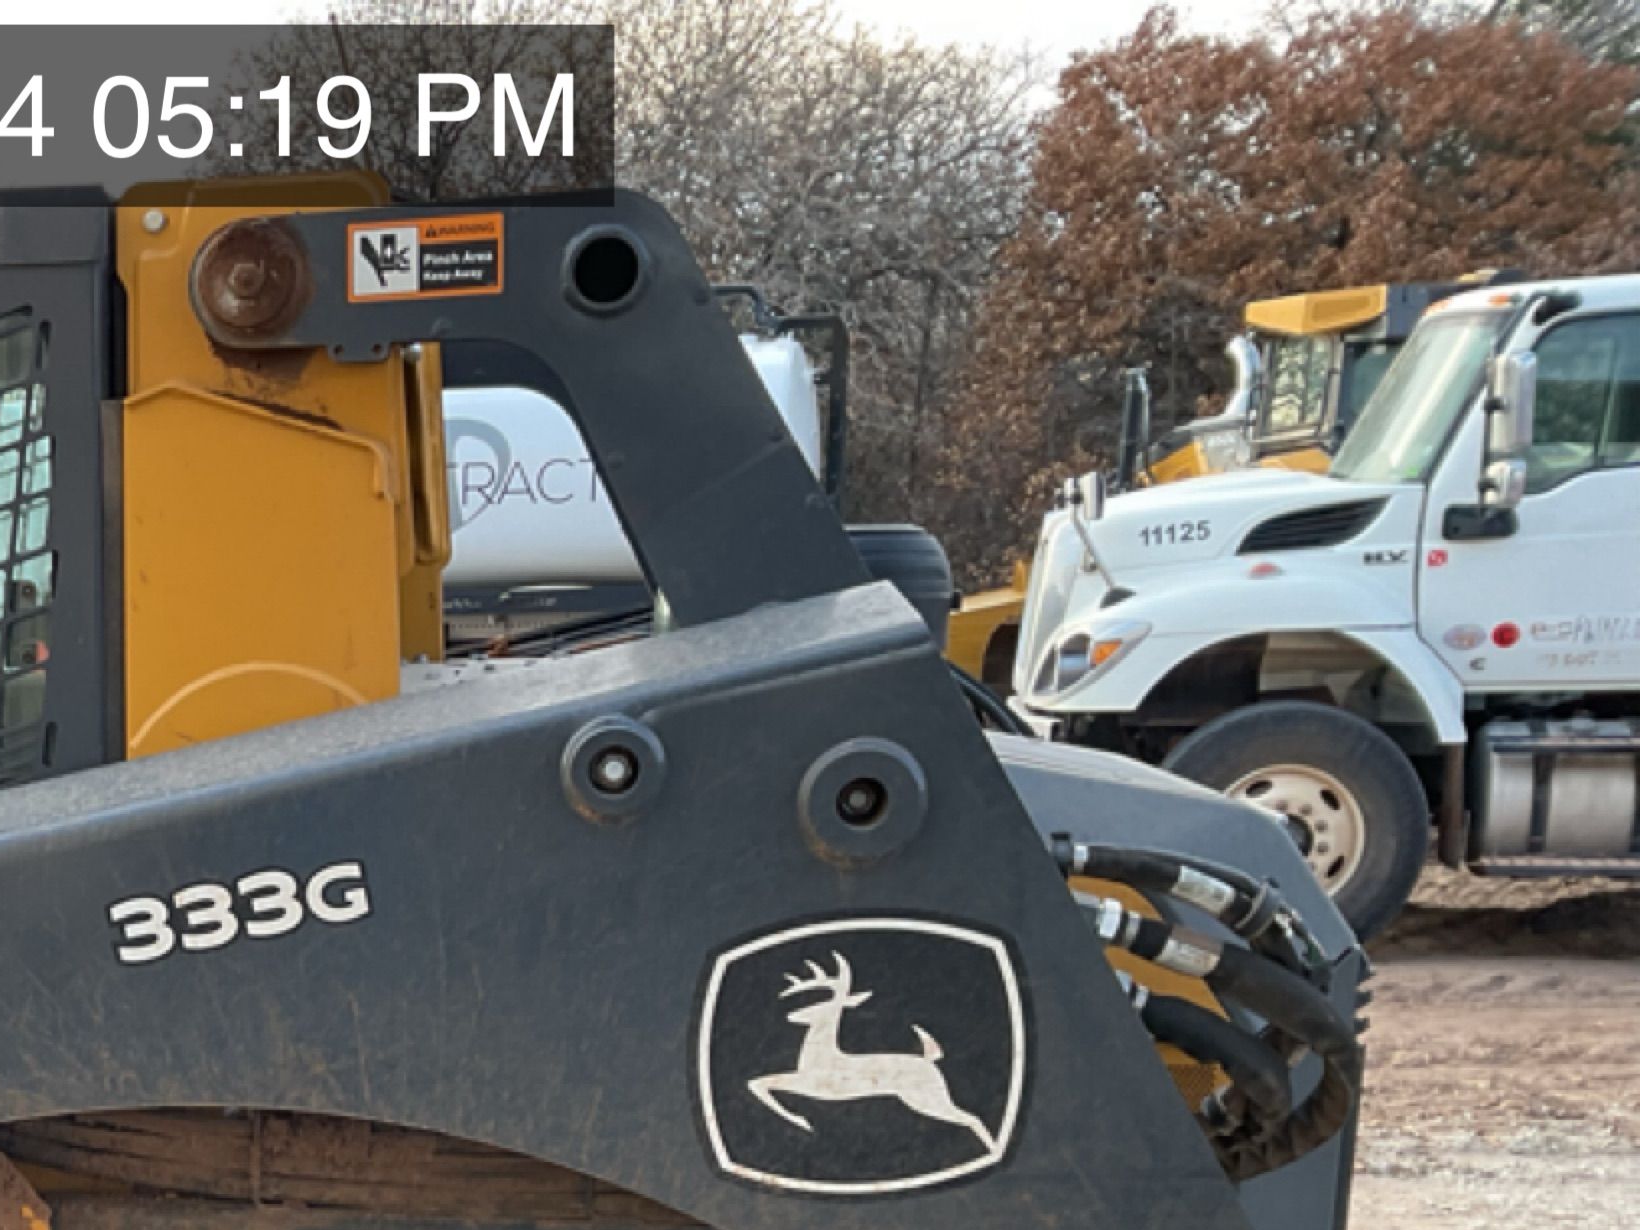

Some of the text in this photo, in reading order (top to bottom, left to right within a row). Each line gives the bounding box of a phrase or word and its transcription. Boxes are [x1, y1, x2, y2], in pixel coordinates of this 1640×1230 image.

[423, 249, 494, 266] Pinch Area
[423, 268, 485, 282] Keep Away
[1138, 519, 1212, 547] 11125
[108, 863, 371, 964] 333G
